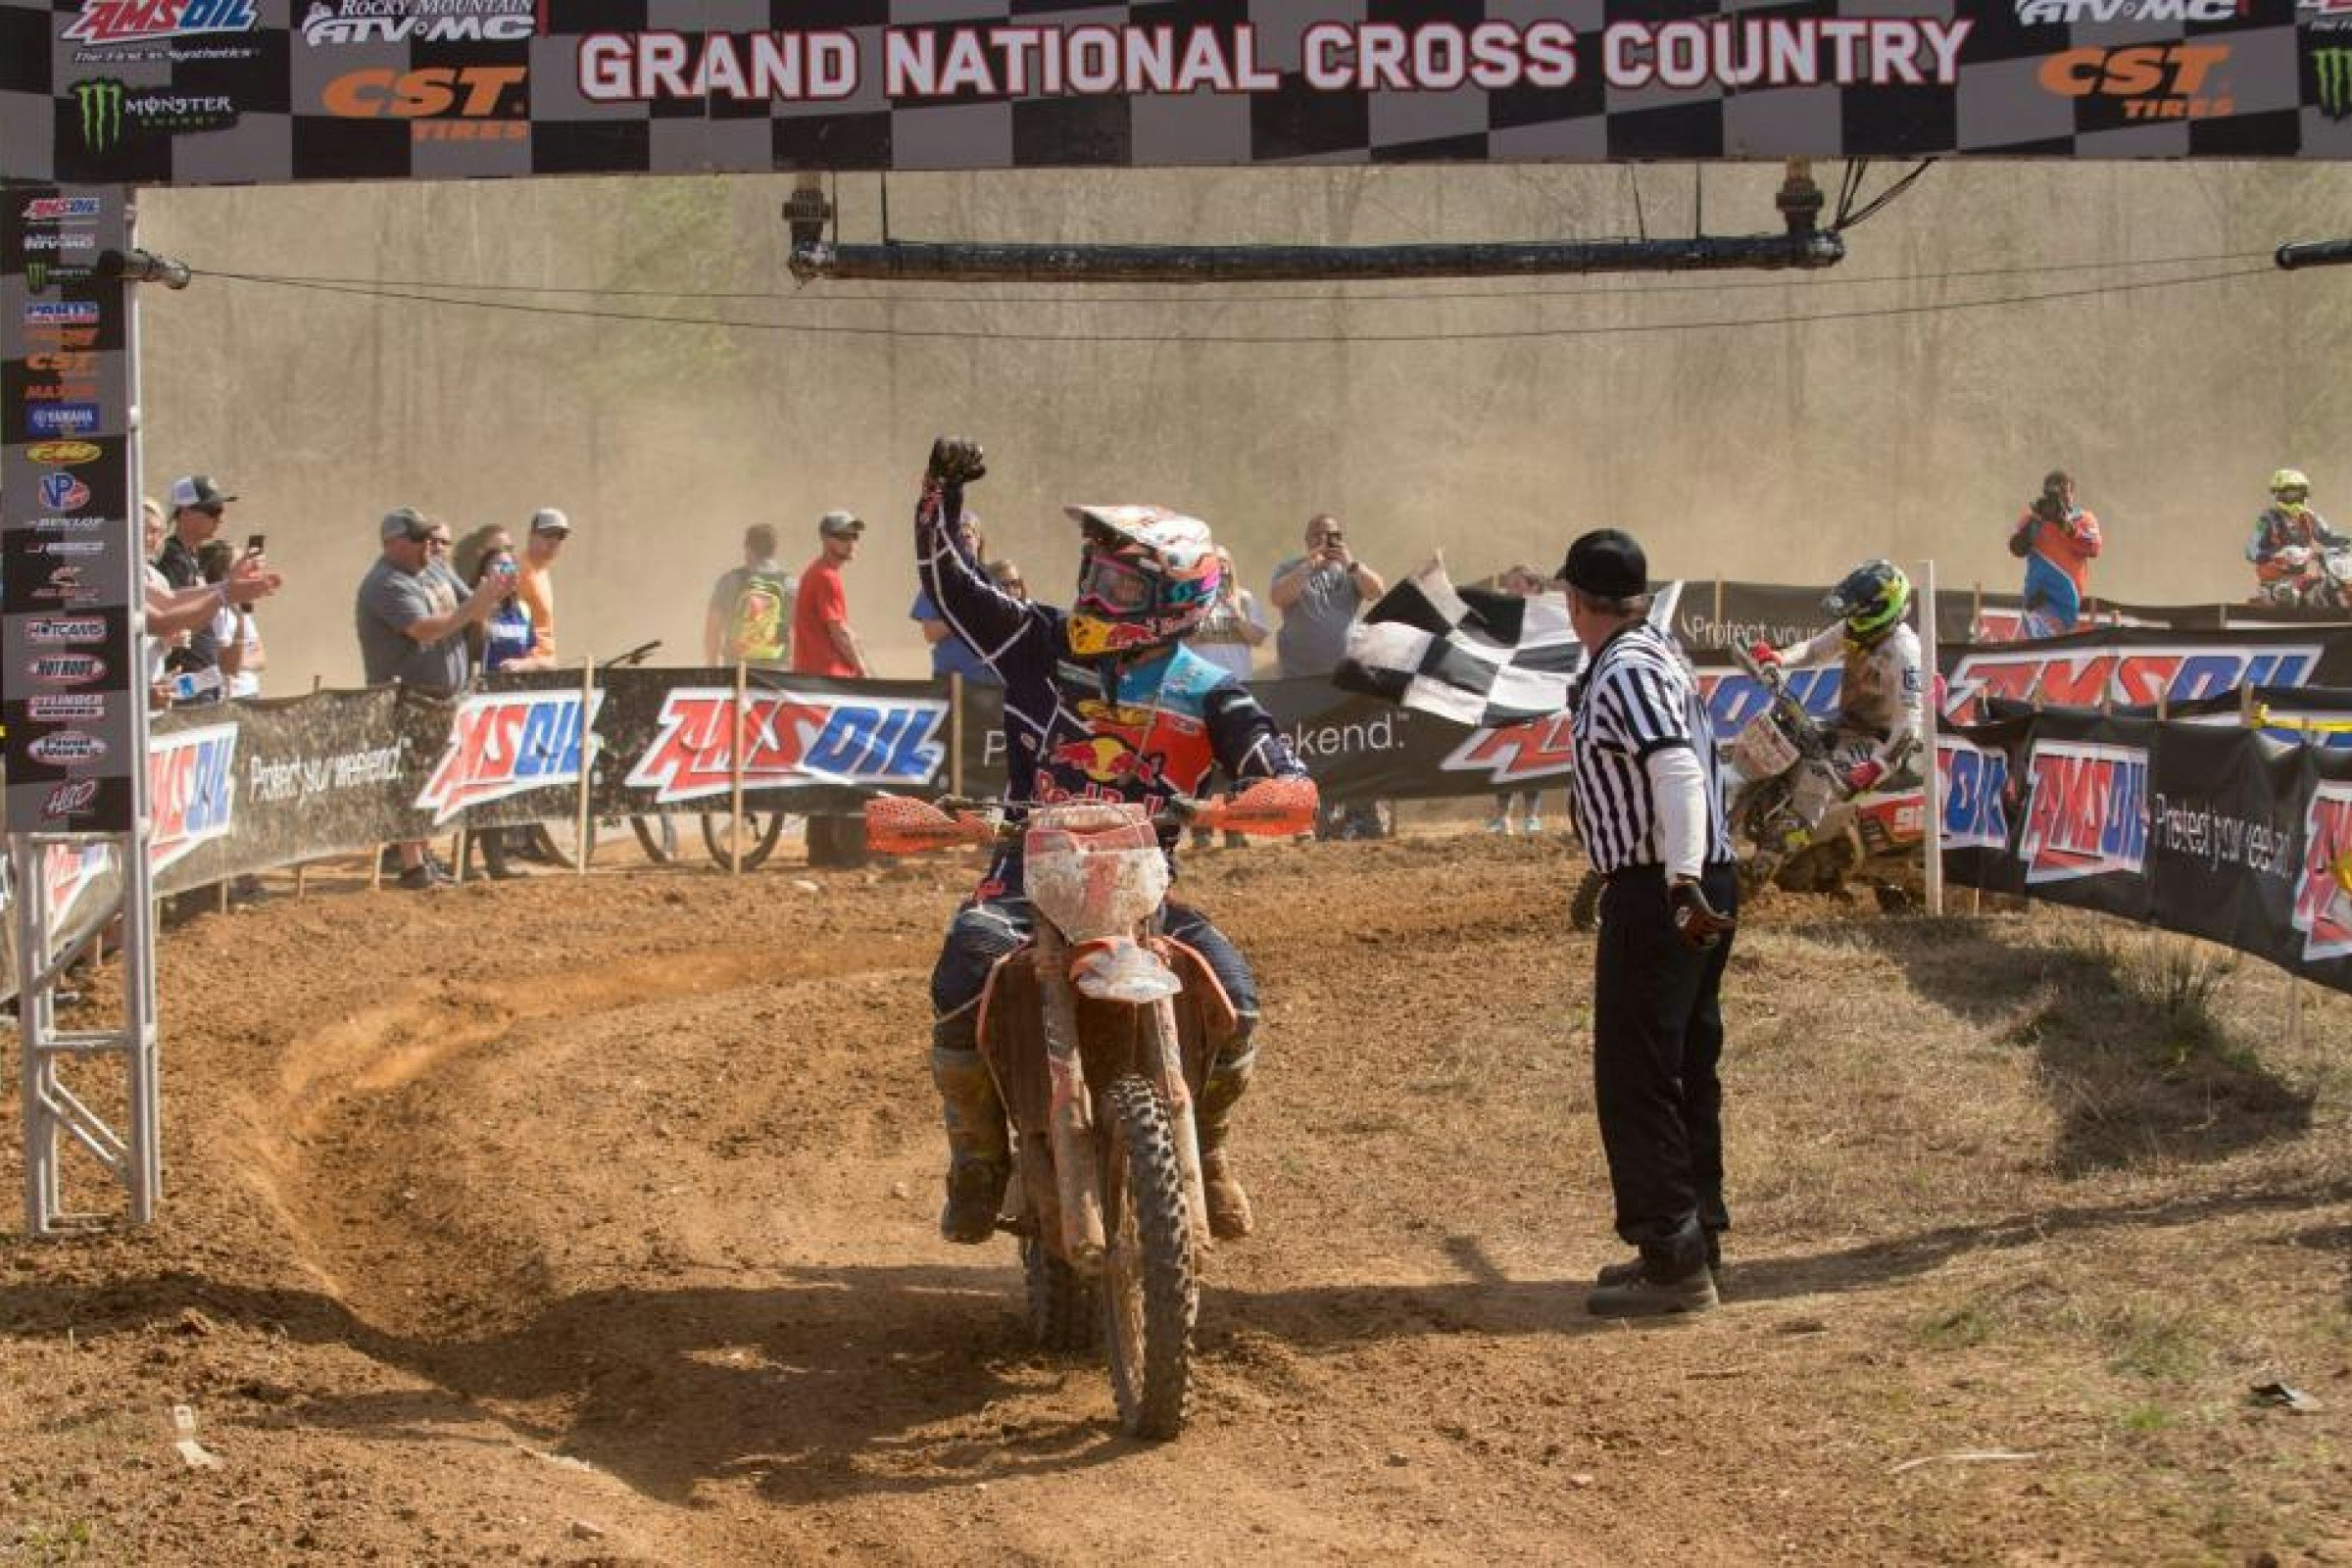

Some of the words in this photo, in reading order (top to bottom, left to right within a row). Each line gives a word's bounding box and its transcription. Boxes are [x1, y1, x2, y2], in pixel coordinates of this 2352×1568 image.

[63, 0, 257, 45] AMSOIL
[577, 30, 862, 100] GRAND
[884, 24, 1281, 96] NATIONAL
[1302, 21, 1577, 90] CROSS
[1604, 18, 1974, 89] COUNTRY
[2037, 44, 2231, 96] CST
[125, 95, 232, 115] MONSTER
[320, 67, 526, 118] CST
[413, 120, 528, 141] TIRES
[631, 691, 948, 799] AMSOIL
[2023, 745, 2148, 878] AMSOIL
